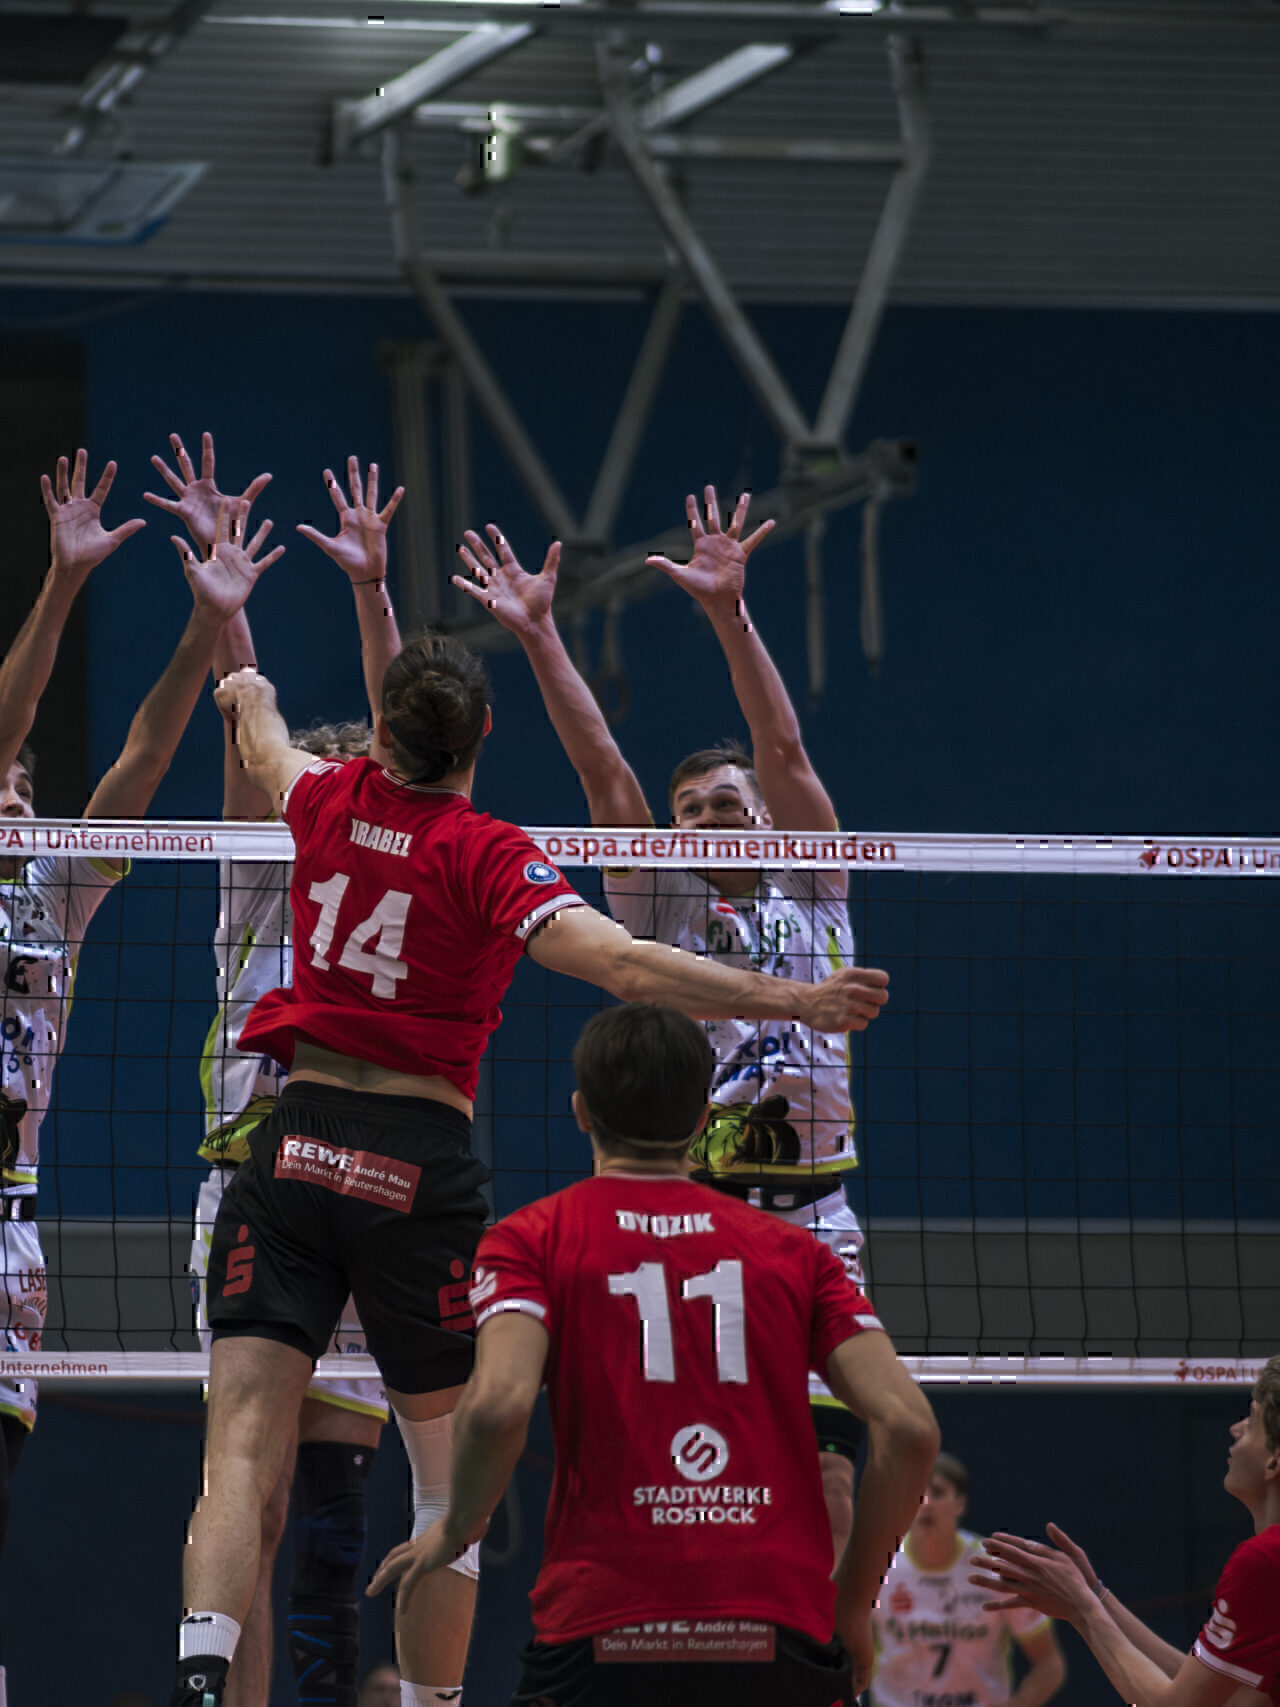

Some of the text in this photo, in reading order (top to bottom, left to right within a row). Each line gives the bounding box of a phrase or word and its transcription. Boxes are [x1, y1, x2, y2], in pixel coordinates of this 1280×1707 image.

[46, 829, 214, 853] Unternehmen
[1167, 846, 1232, 869] OSPA
[308, 871, 414, 1000] 14
[284, 1141, 412, 1189] REWE André Mau
[281, 1159, 408, 1203] Dein Markt in Reutershagen
[607, 1260, 750, 1385] 11
[1192, 1366, 1238, 1381] OSPA
[632, 1486, 772, 1506] STADTWERKE
[652, 1506, 757, 1525] ROSTOCK
[602, 1639, 628, 1652] Dein
[631, 1638, 668, 1651] Markt
